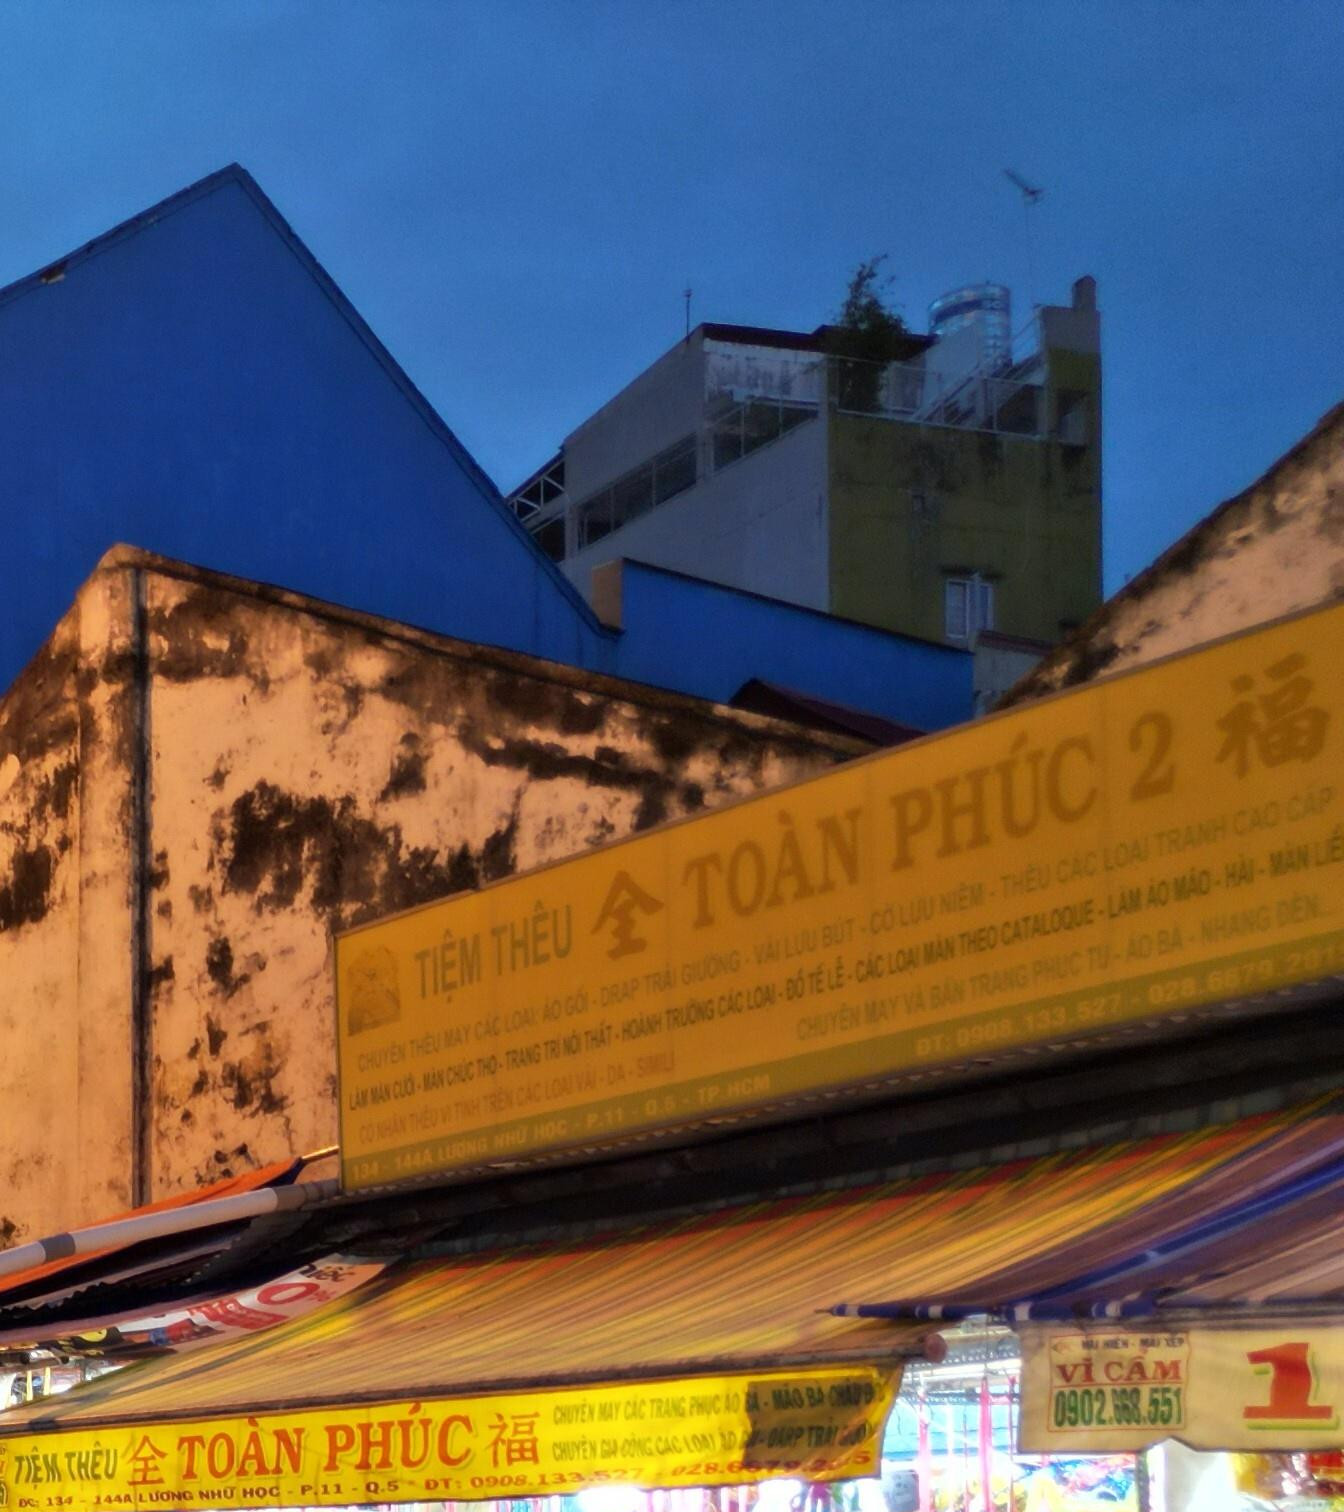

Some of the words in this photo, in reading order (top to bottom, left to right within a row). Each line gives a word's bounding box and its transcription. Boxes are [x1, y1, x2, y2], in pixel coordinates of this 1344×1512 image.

[1214, 652, 1330, 779] 福
[683, 806, 862, 930] TOÀN
[890, 731, 1097, 871] PHÚC
[1130, 710, 1176, 800] 2
[592, 870, 664, 960] 全
[957, 924, 997, 957] THEO
[414, 928, 482, 1003] TIỆM
[492, 901, 571, 969] THÊU
[553, 1397, 596, 1425] CHUYÊN
[598, 1401, 621, 1421] MAY
[650, 1396, 686, 1419] TRANG
[14, 1446, 62, 1490] TIỆM
[65, 1441, 119, 1482] THÊU
[127, 1435, 167, 1486] 全
[177, 1416, 305, 1480] TOÀN
[323, 1402, 475, 1472] PHÚC
[488, 1411, 541, 1468] 福
[552, 1434, 597, 1462] CHUYÊN
[45, 1495, 74, 1507] 134
[95, 1492, 134, 1506] 144A
[242, 1485, 281, 1502] HỌC
[301, 1484, 343, 1497] P.11
[365, 1480, 400, 1496] Q.5
